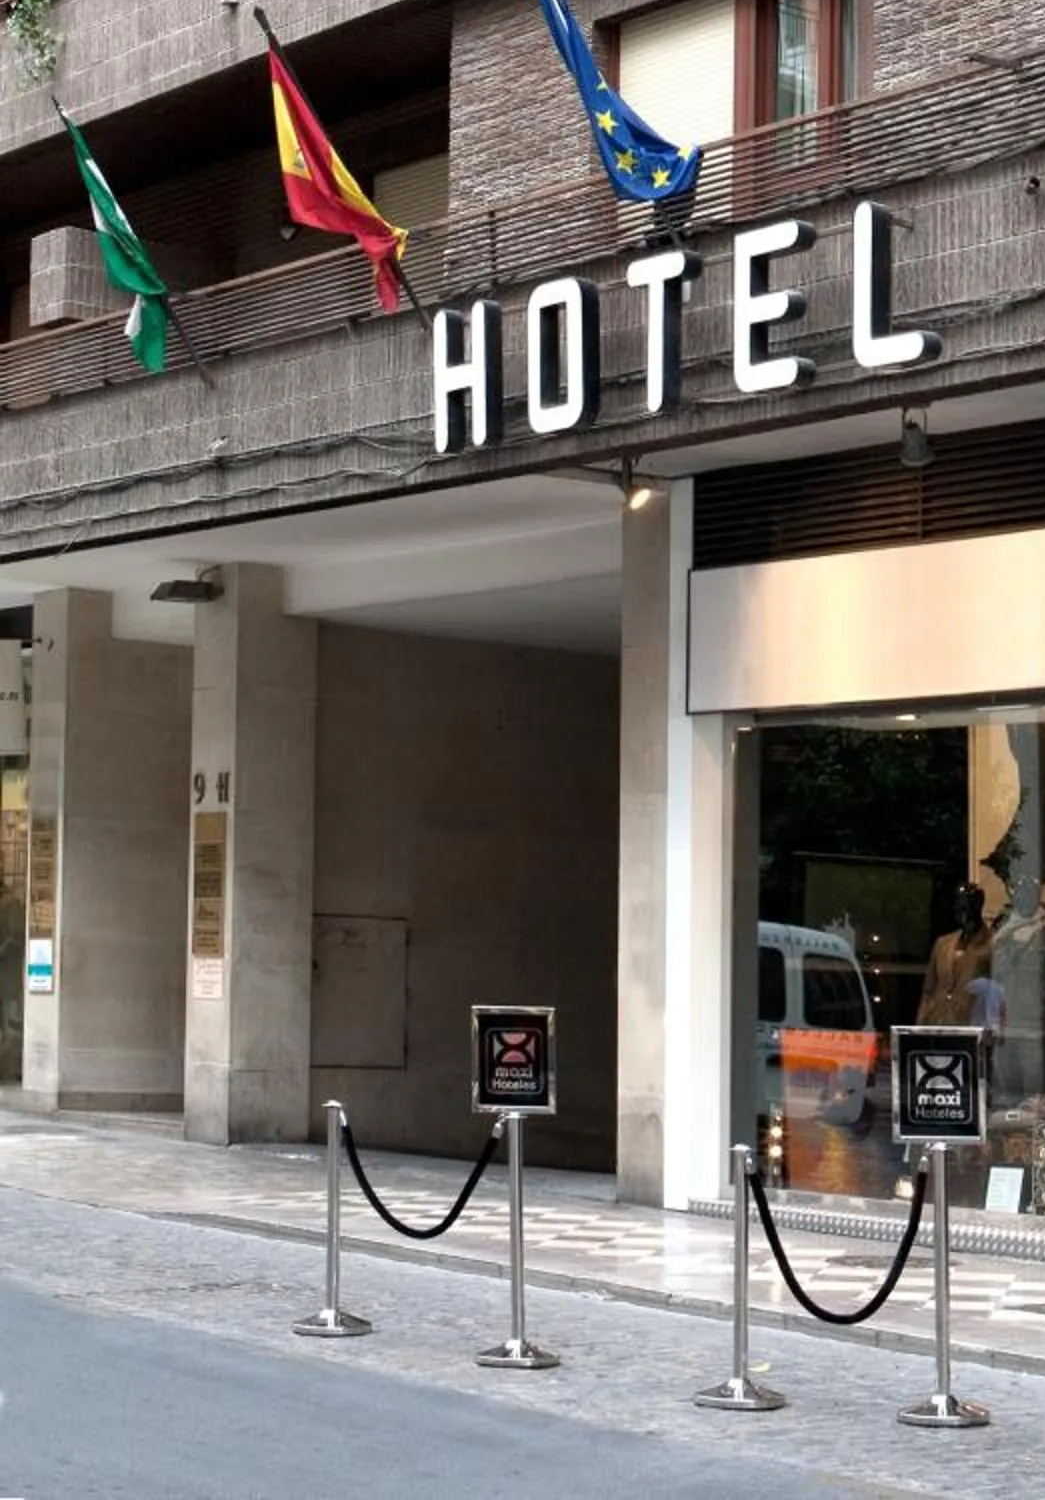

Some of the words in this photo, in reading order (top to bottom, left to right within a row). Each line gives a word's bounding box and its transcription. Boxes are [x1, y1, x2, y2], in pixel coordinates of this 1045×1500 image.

[433, 201, 930, 453] HOTEL
[495, 1064, 533, 1077] maxi
[917, 1090, 961, 1105] maxi
[915, 1106, 965, 1119] Hoteles
